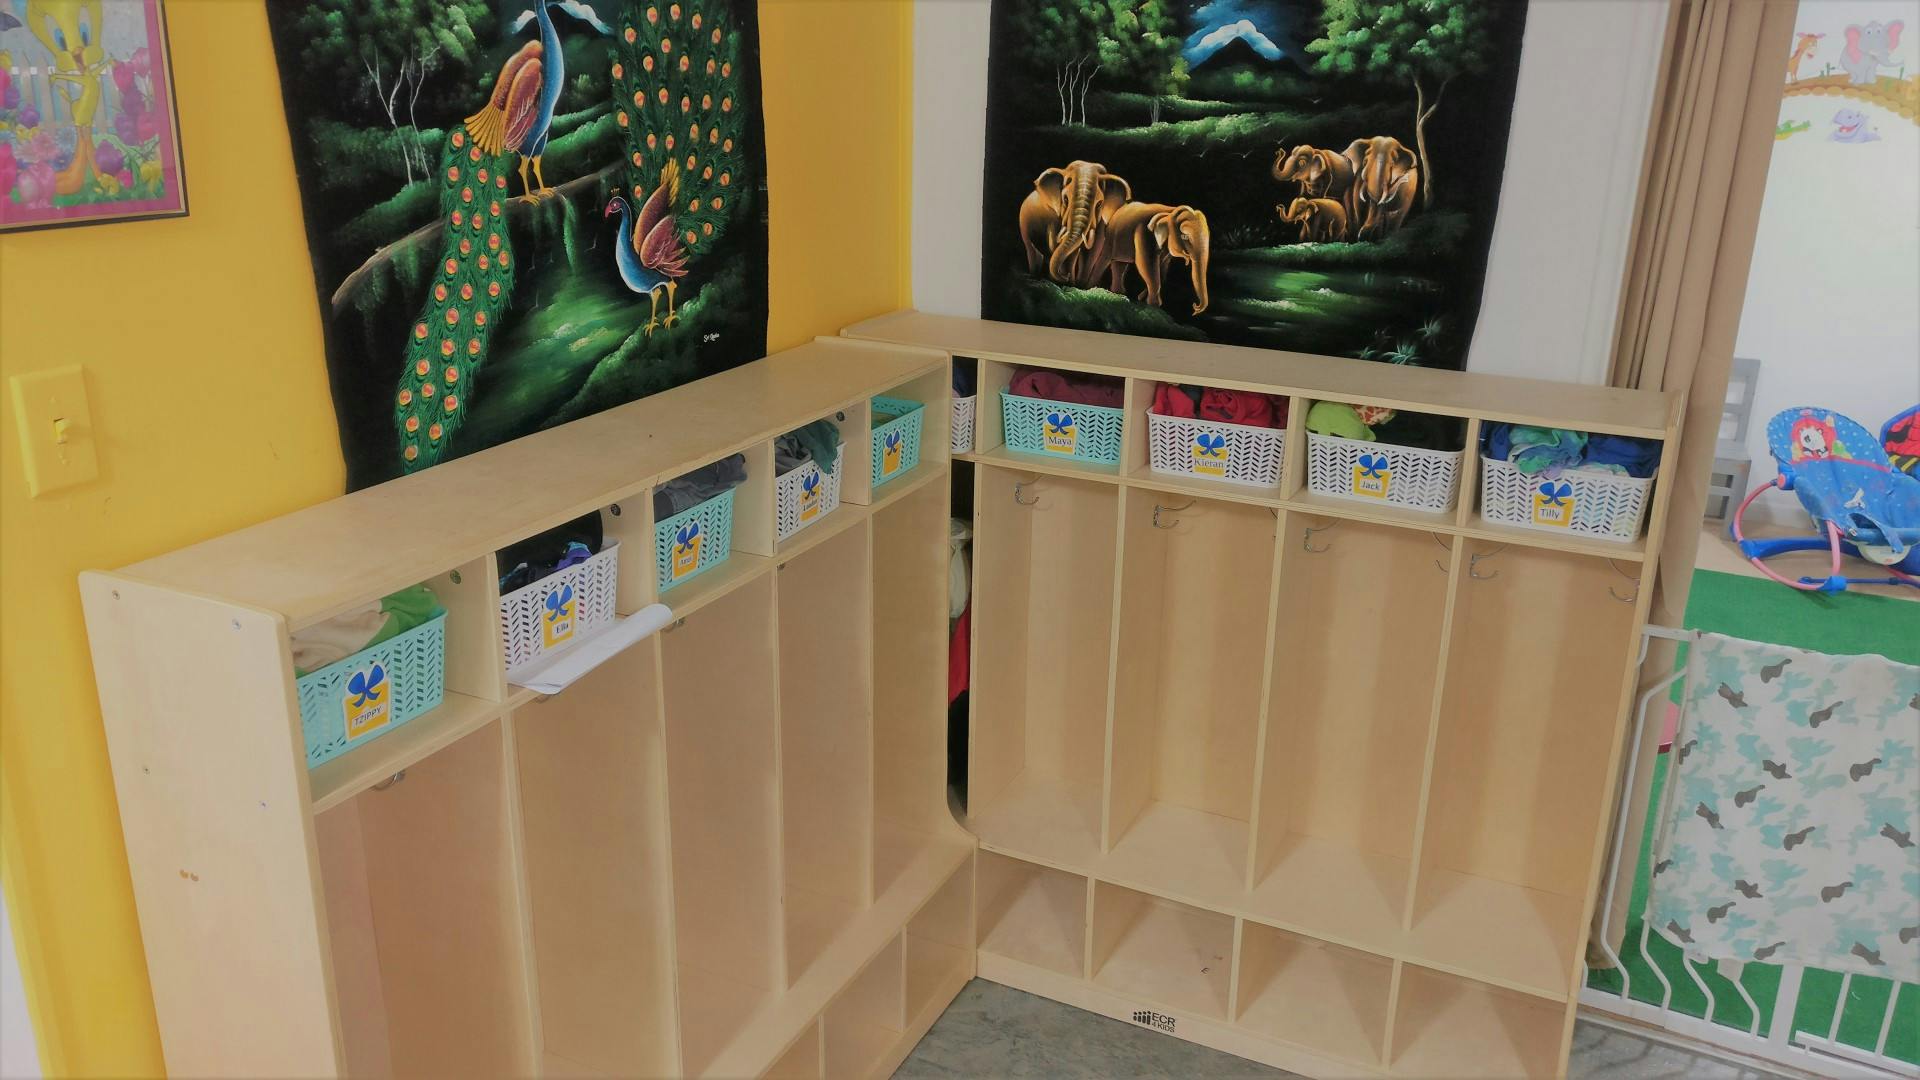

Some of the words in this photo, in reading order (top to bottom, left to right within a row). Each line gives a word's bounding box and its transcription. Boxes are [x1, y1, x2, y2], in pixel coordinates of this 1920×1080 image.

[1049, 436, 1072, 447] Maya
[1194, 458, 1224, 469] Kieran
[1362, 480, 1379, 489] Jack
[1540, 508, 1560, 520] Tilly
[353, 705, 383, 726] TZIPPY
[1152, 1012, 1176, 1027] ECR
